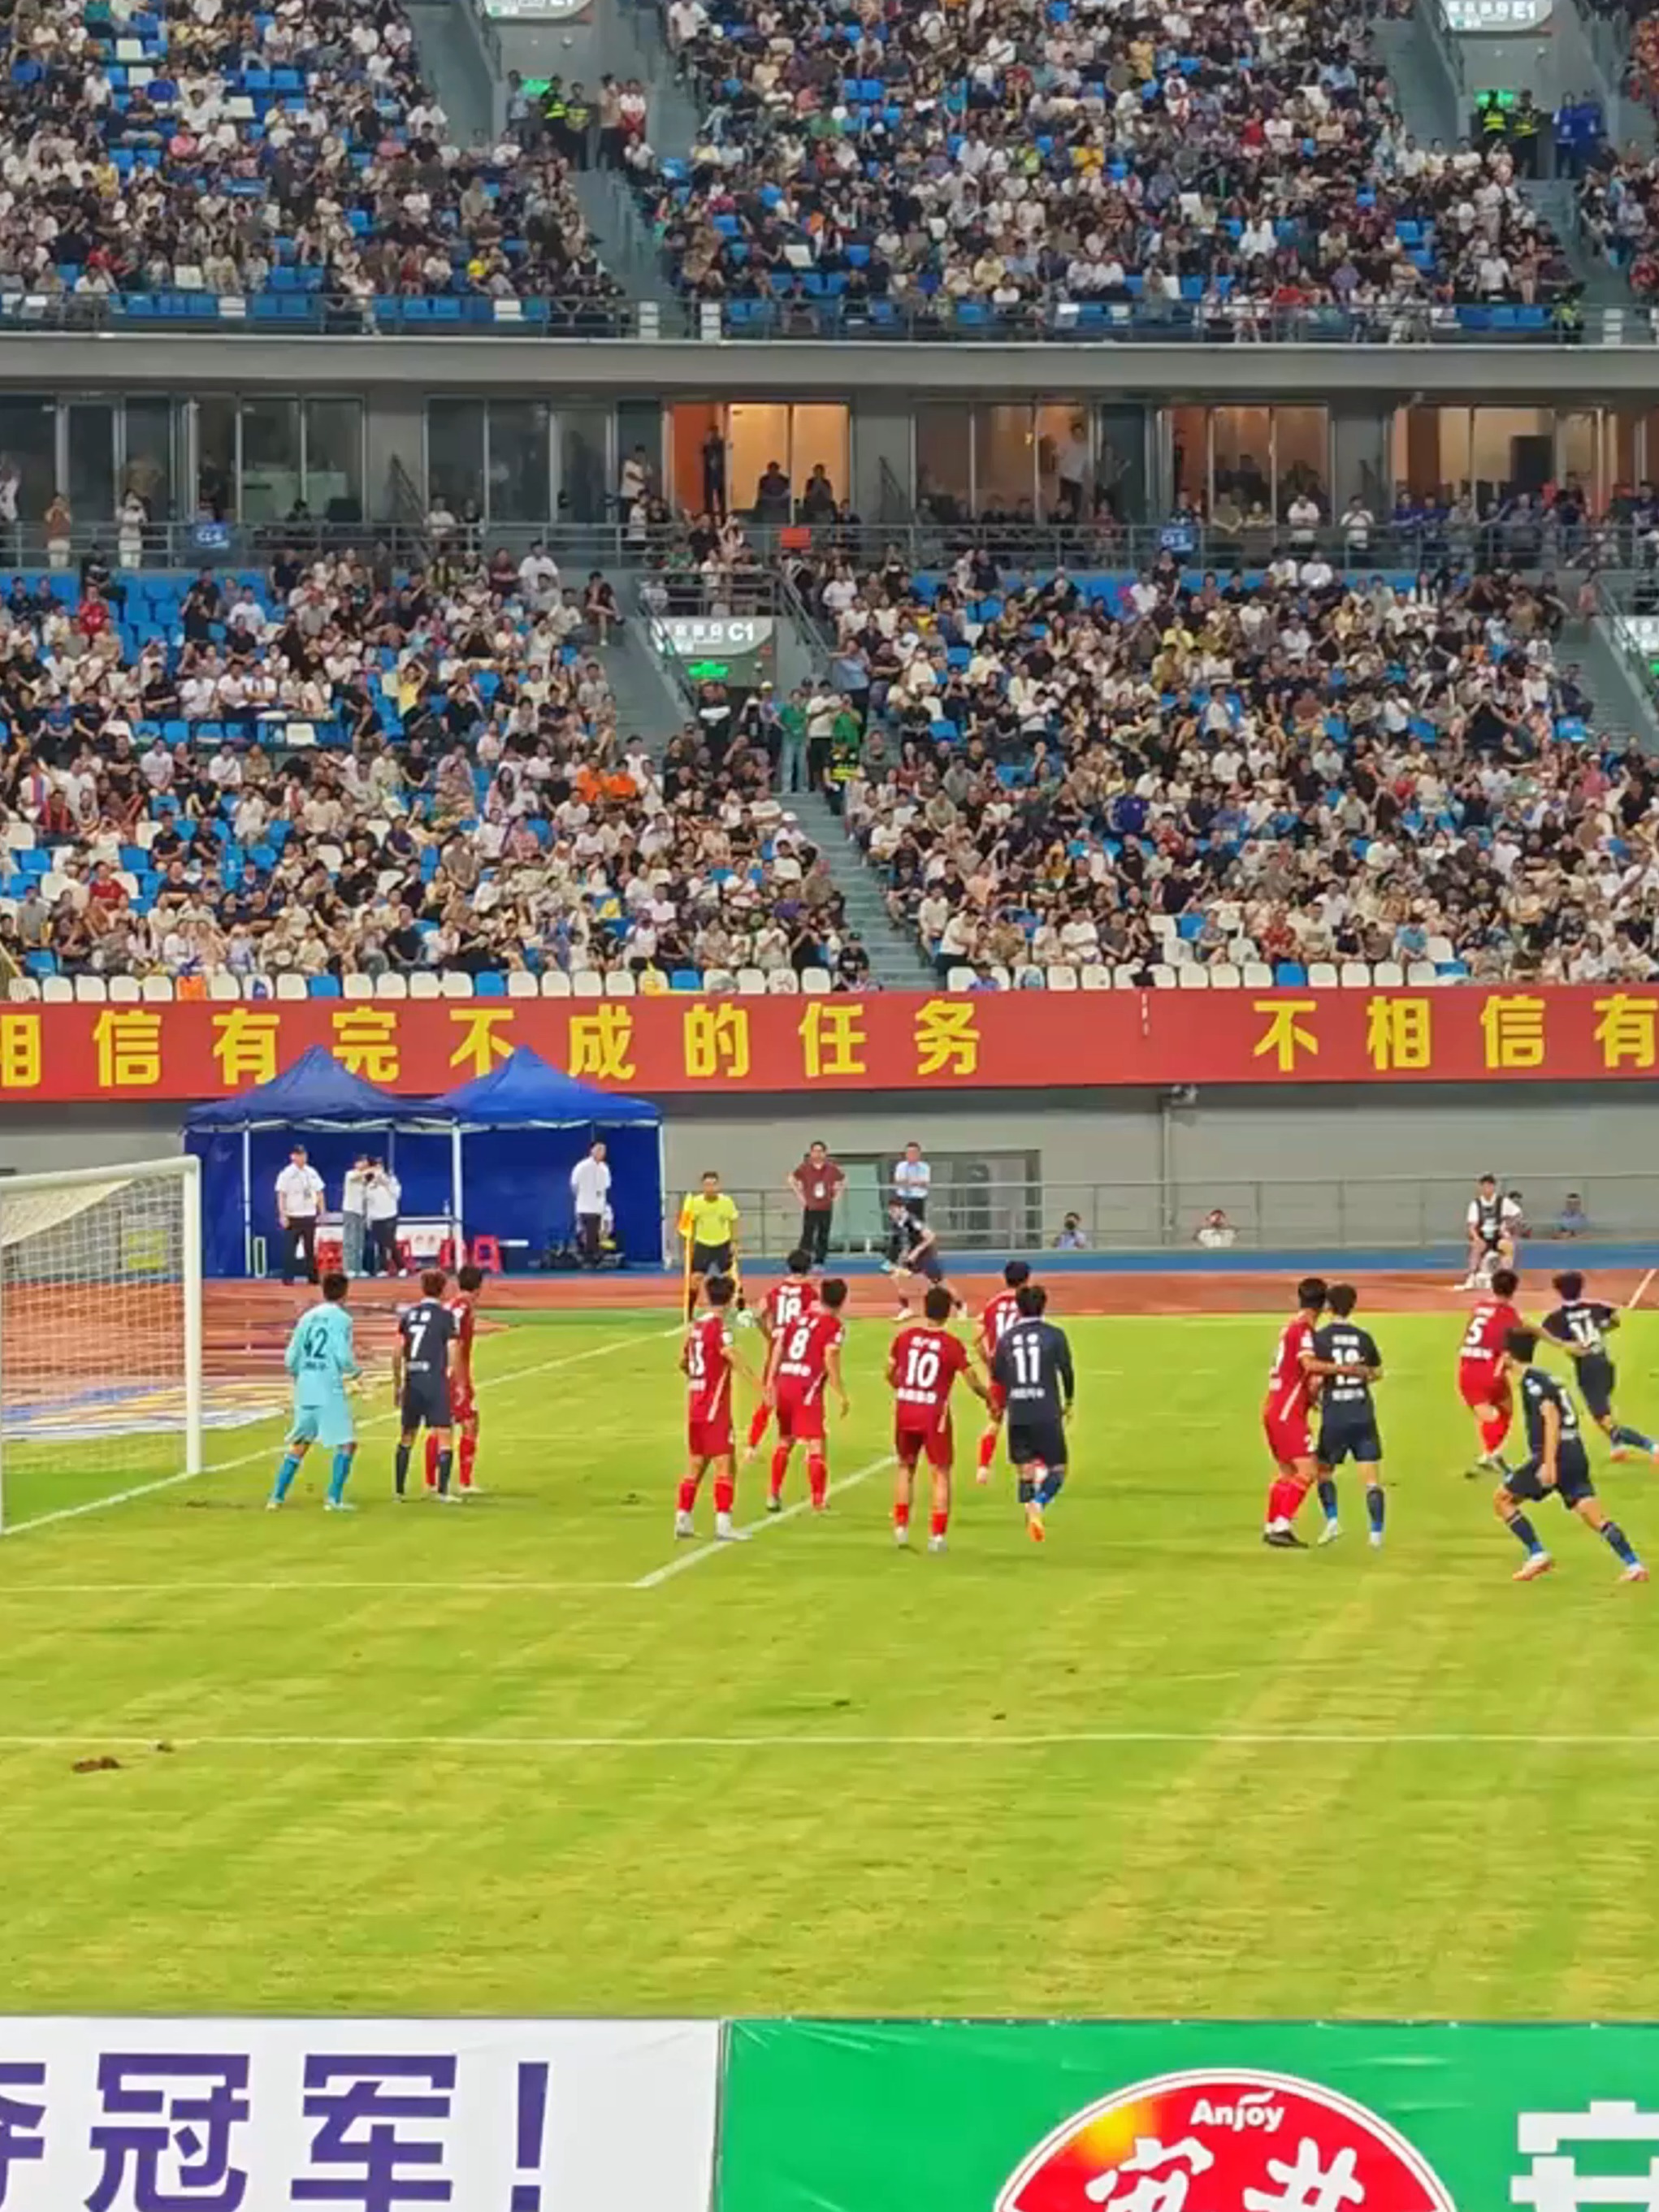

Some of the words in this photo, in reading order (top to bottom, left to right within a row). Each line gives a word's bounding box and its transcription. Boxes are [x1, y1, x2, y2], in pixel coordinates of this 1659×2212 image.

[728, 622, 754, 641] C1
[0, 1001, 980, 1087] 相信有完不成的任务
[1254, 993, 1659, 1072] 不相信有
[303, 1327, 329, 1359] 42
[409, 1324, 427, 1359] 7
[789, 1327, 810, 1360] 8
[1465, 1317, 1488, 1346] 5
[906, 1348, 940, 1388] 10
[1012, 1346, 1040, 1383] 11
[1189, 2090, 1285, 2132] Anjoy
